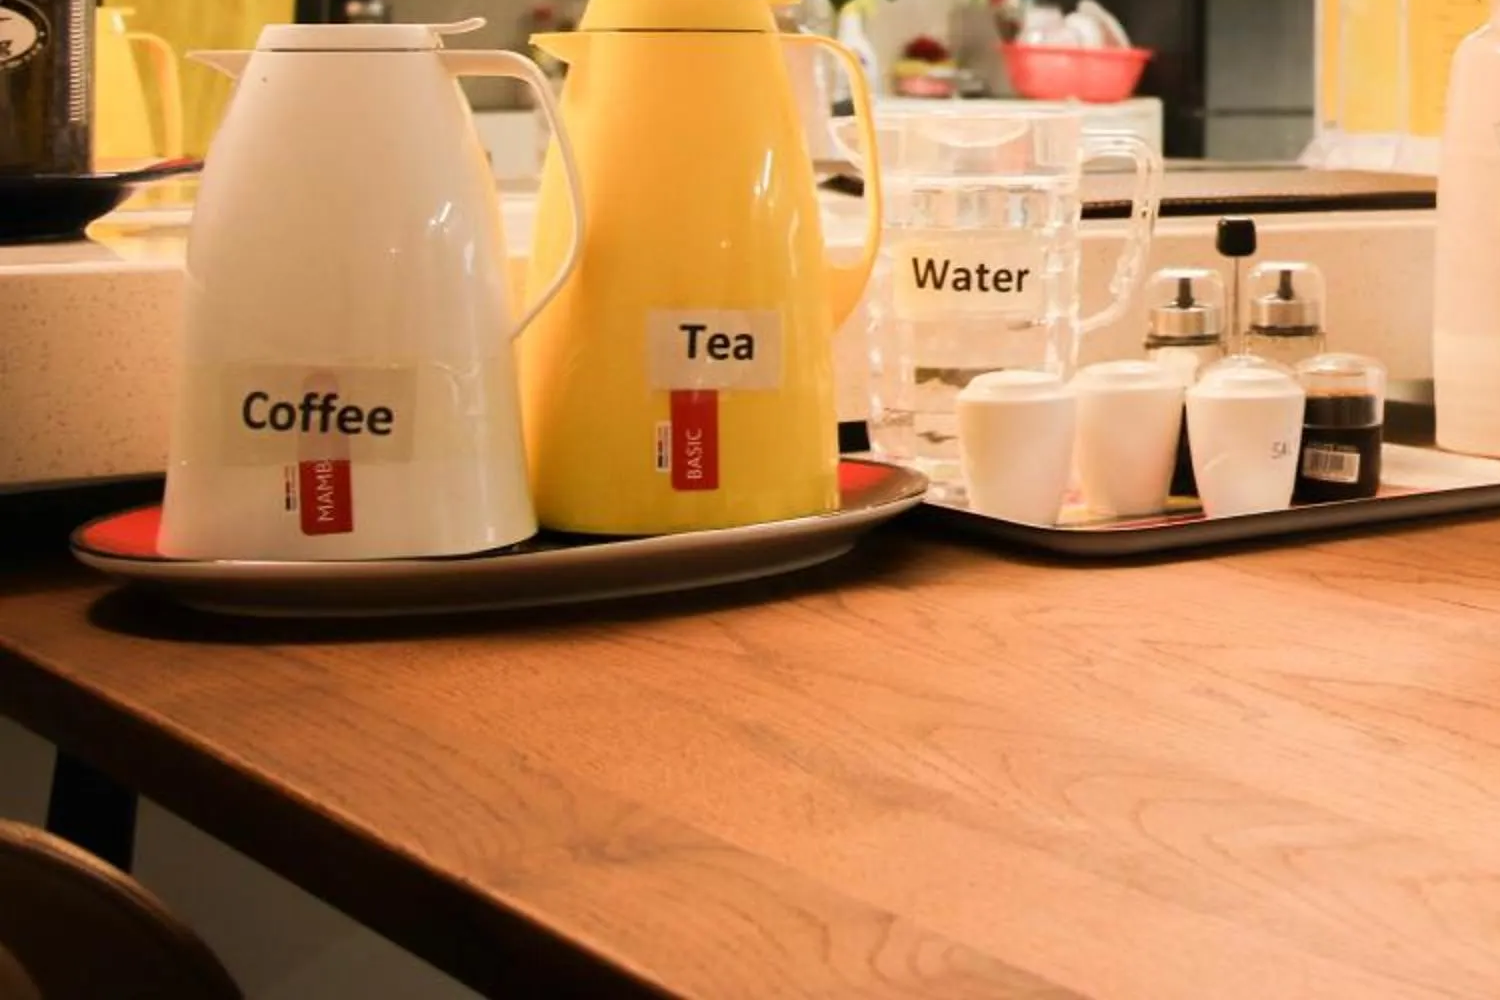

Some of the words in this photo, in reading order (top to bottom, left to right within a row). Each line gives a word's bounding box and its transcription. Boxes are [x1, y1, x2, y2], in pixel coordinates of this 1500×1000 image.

[911, 256, 1031, 292] Water
[678, 323, 756, 361] Tea
[242, 391, 395, 436] Coffee
[685, 427, 704, 480] BASIC
[315, 456, 336, 521] MAMB
